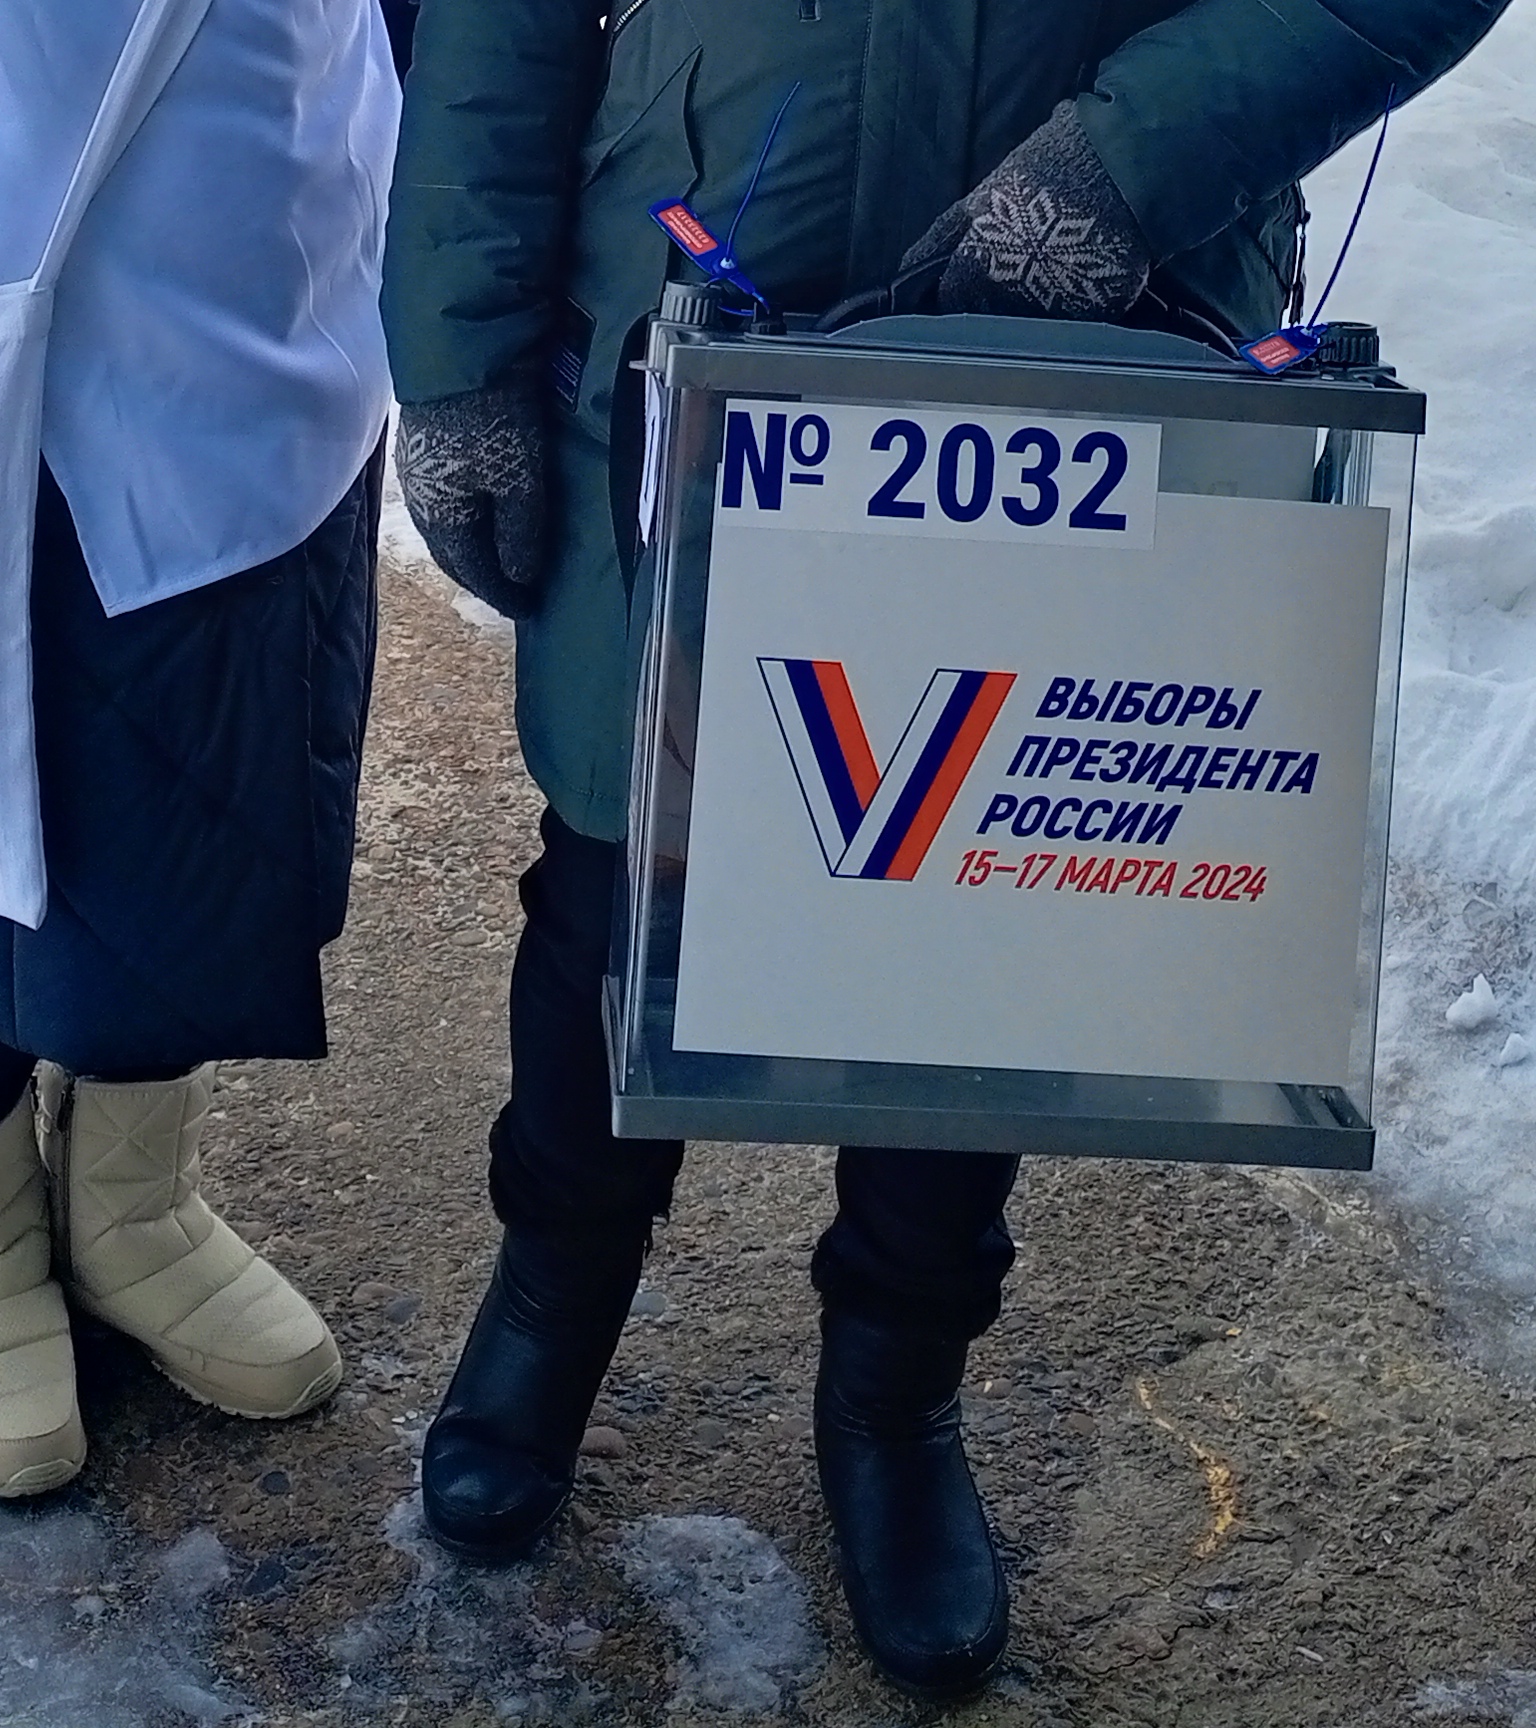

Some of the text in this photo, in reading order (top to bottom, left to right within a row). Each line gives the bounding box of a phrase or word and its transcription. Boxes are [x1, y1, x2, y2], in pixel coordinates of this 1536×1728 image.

[721, 410, 1129, 532] № 2032
[1035, 676, 1263, 731] ВЫБОРЫ
[1005, 734, 1320, 794] ПРЕЗИДЕНТА
[975, 793, 1184, 846] РОССИИ
[954, 849, 1268, 903] 15–17 МАРТА 2024
